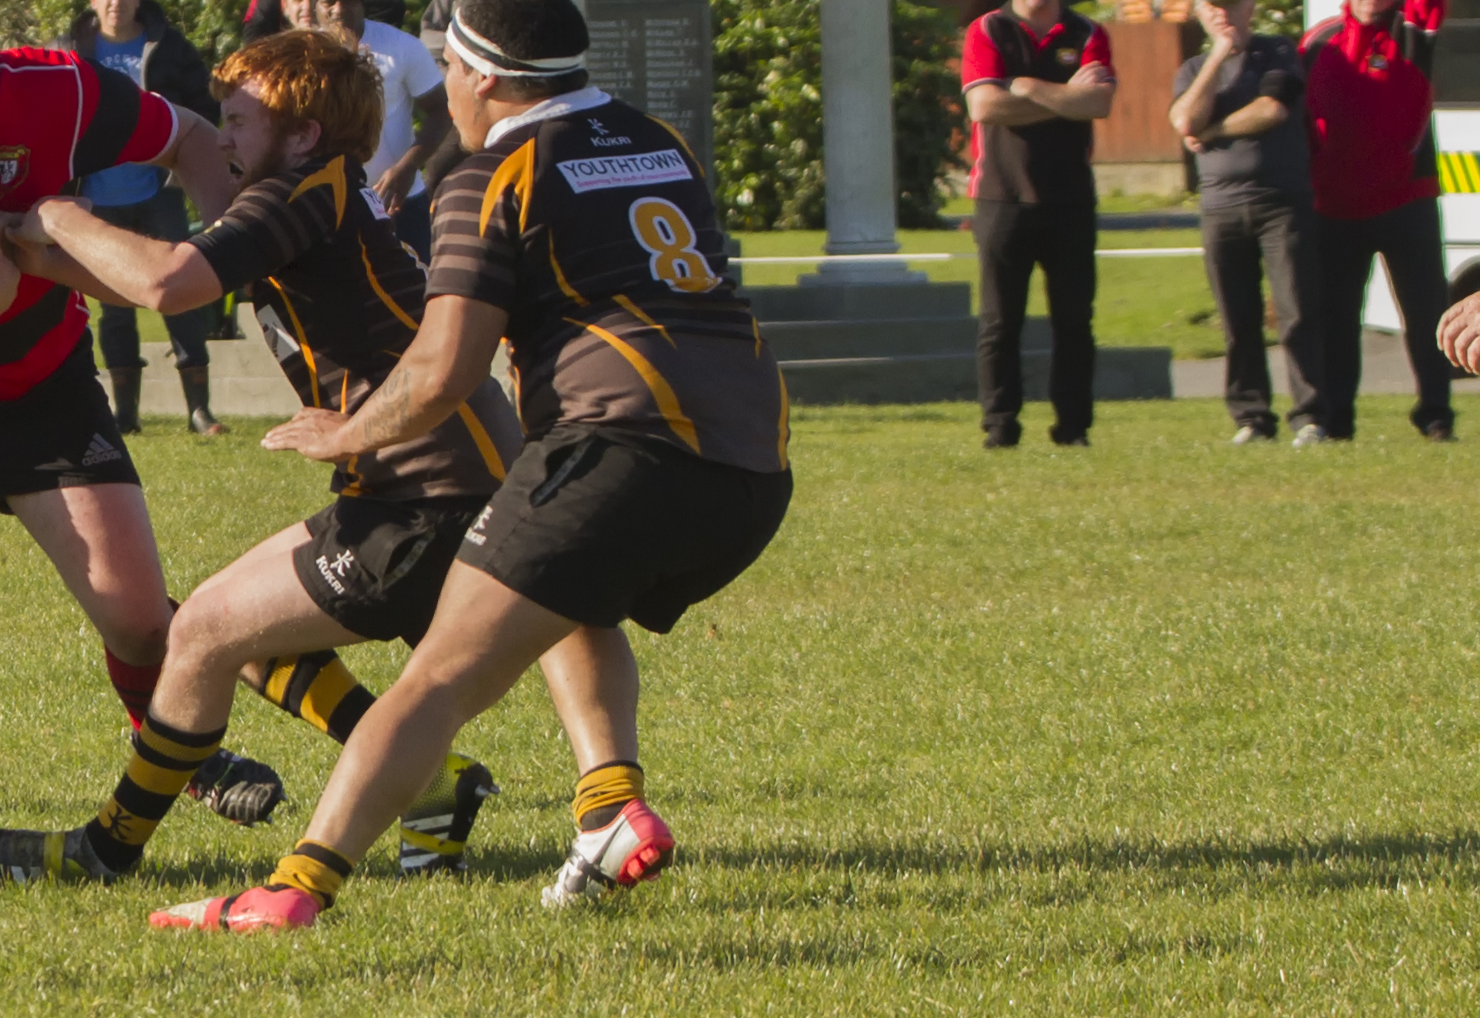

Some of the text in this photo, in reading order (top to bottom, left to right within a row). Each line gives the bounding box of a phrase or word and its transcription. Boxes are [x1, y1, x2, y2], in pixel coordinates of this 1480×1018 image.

[590, 136, 632, 147] KUKRI
[563, 151, 684, 178] YOUTHTOWN
[628, 196, 723, 294] 8
[82, 449, 123, 467] adidas
[315, 555, 346, 595] KUKRI
